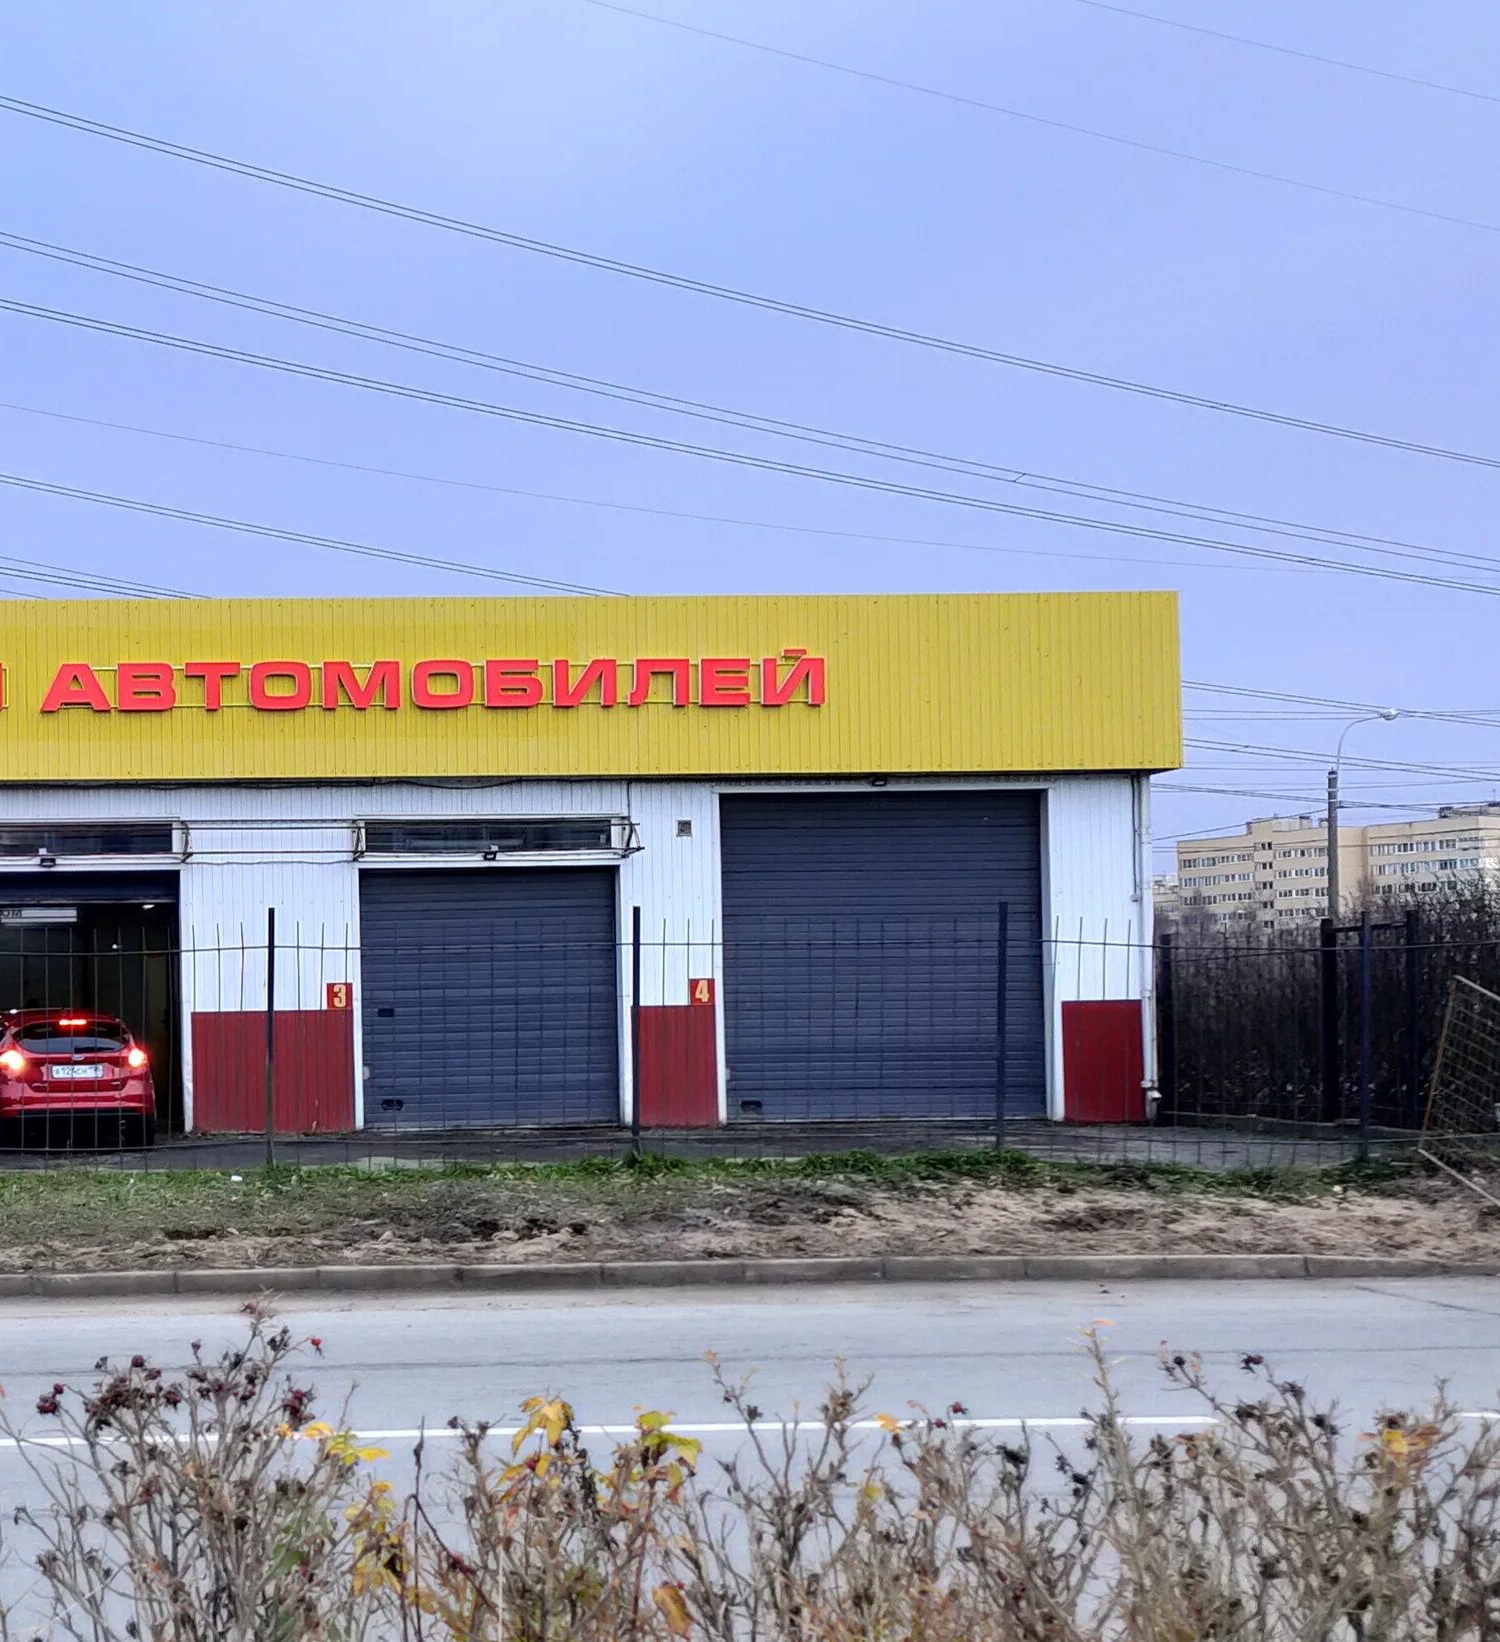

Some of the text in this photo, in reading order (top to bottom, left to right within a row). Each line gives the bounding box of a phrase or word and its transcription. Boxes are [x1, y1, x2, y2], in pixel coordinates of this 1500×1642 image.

[41, 649, 826, 712] АВТОМОБИЛЕЙ
[333, 983, 347, 1008] 3
[695, 979, 709, 1003] 4
